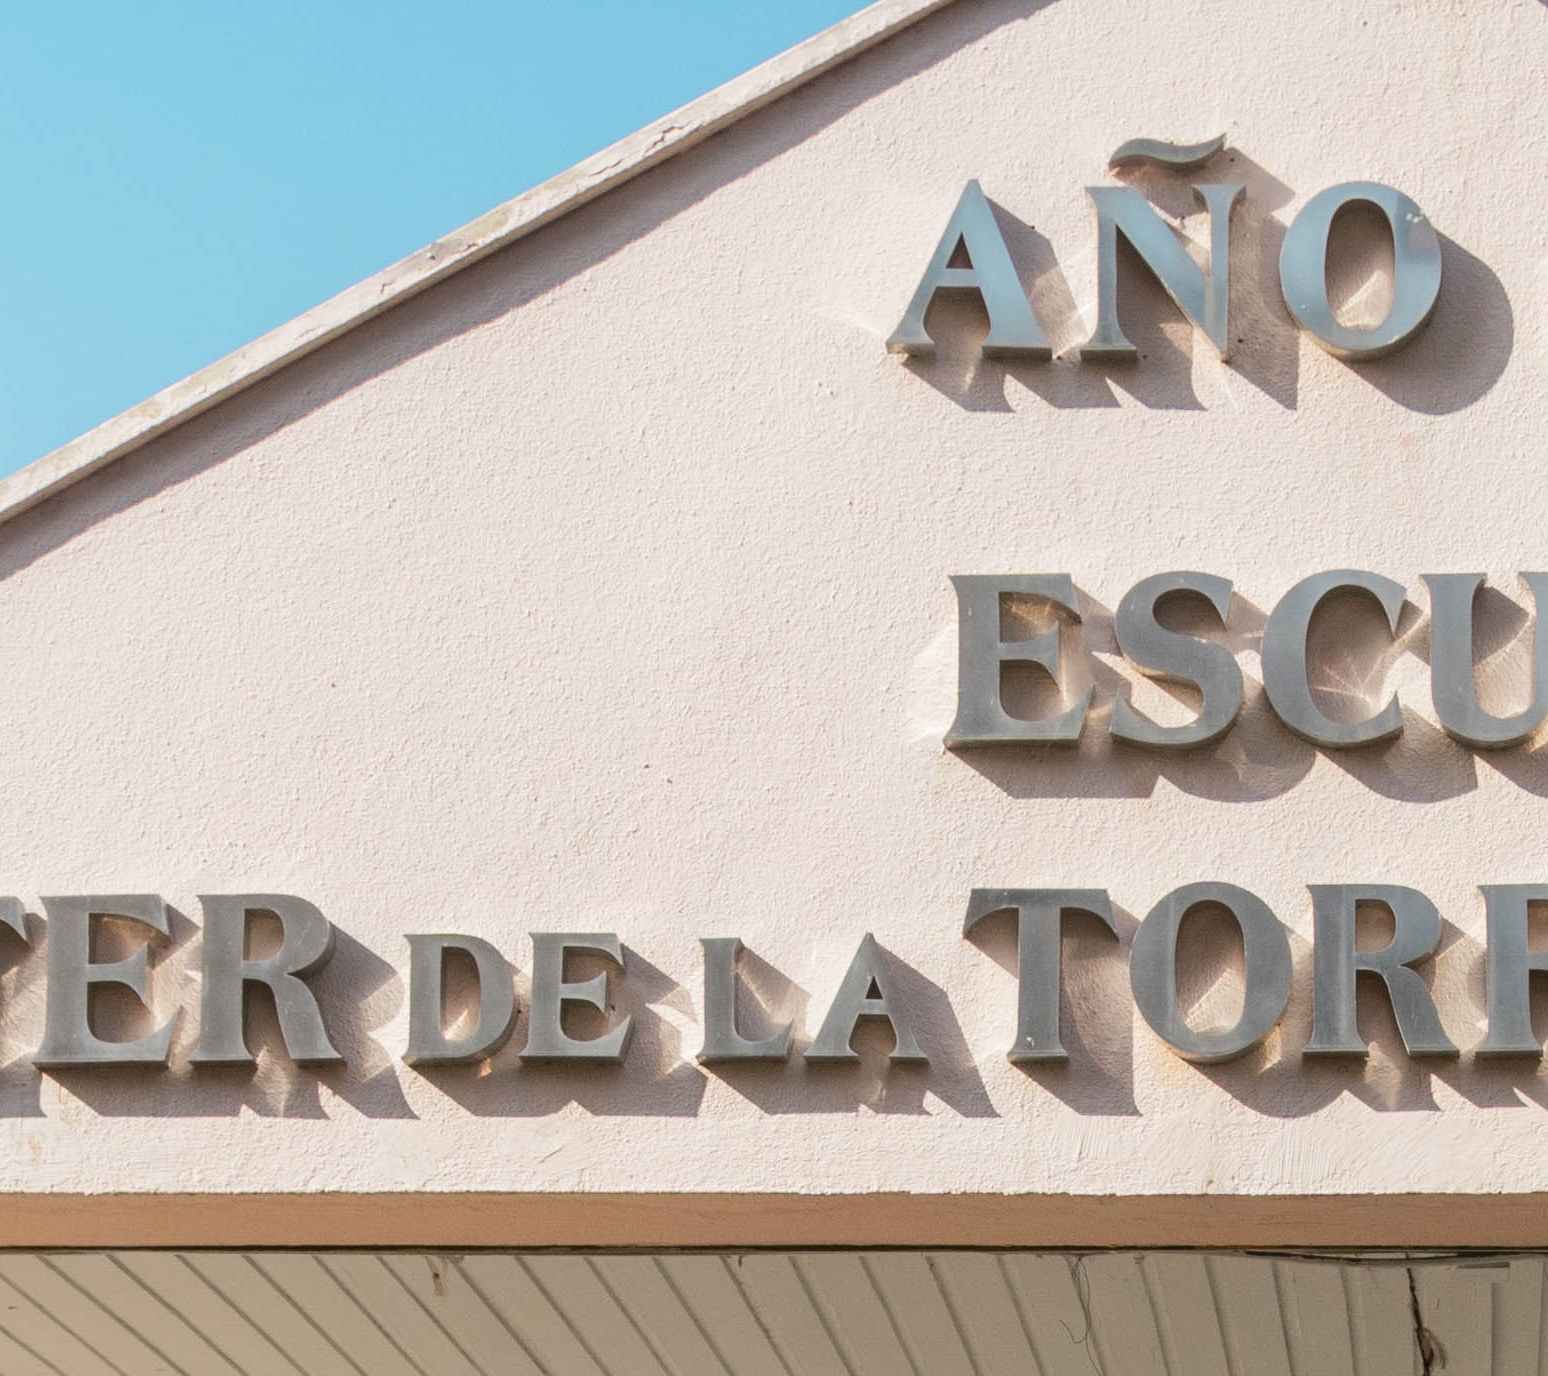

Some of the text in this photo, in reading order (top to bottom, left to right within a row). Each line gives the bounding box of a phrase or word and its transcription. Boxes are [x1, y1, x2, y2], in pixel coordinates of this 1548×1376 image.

[885, 132, 1444, 364] AÑO
[401, 930, 634, 1067] DE
[694, 931, 931, 1066] LA
